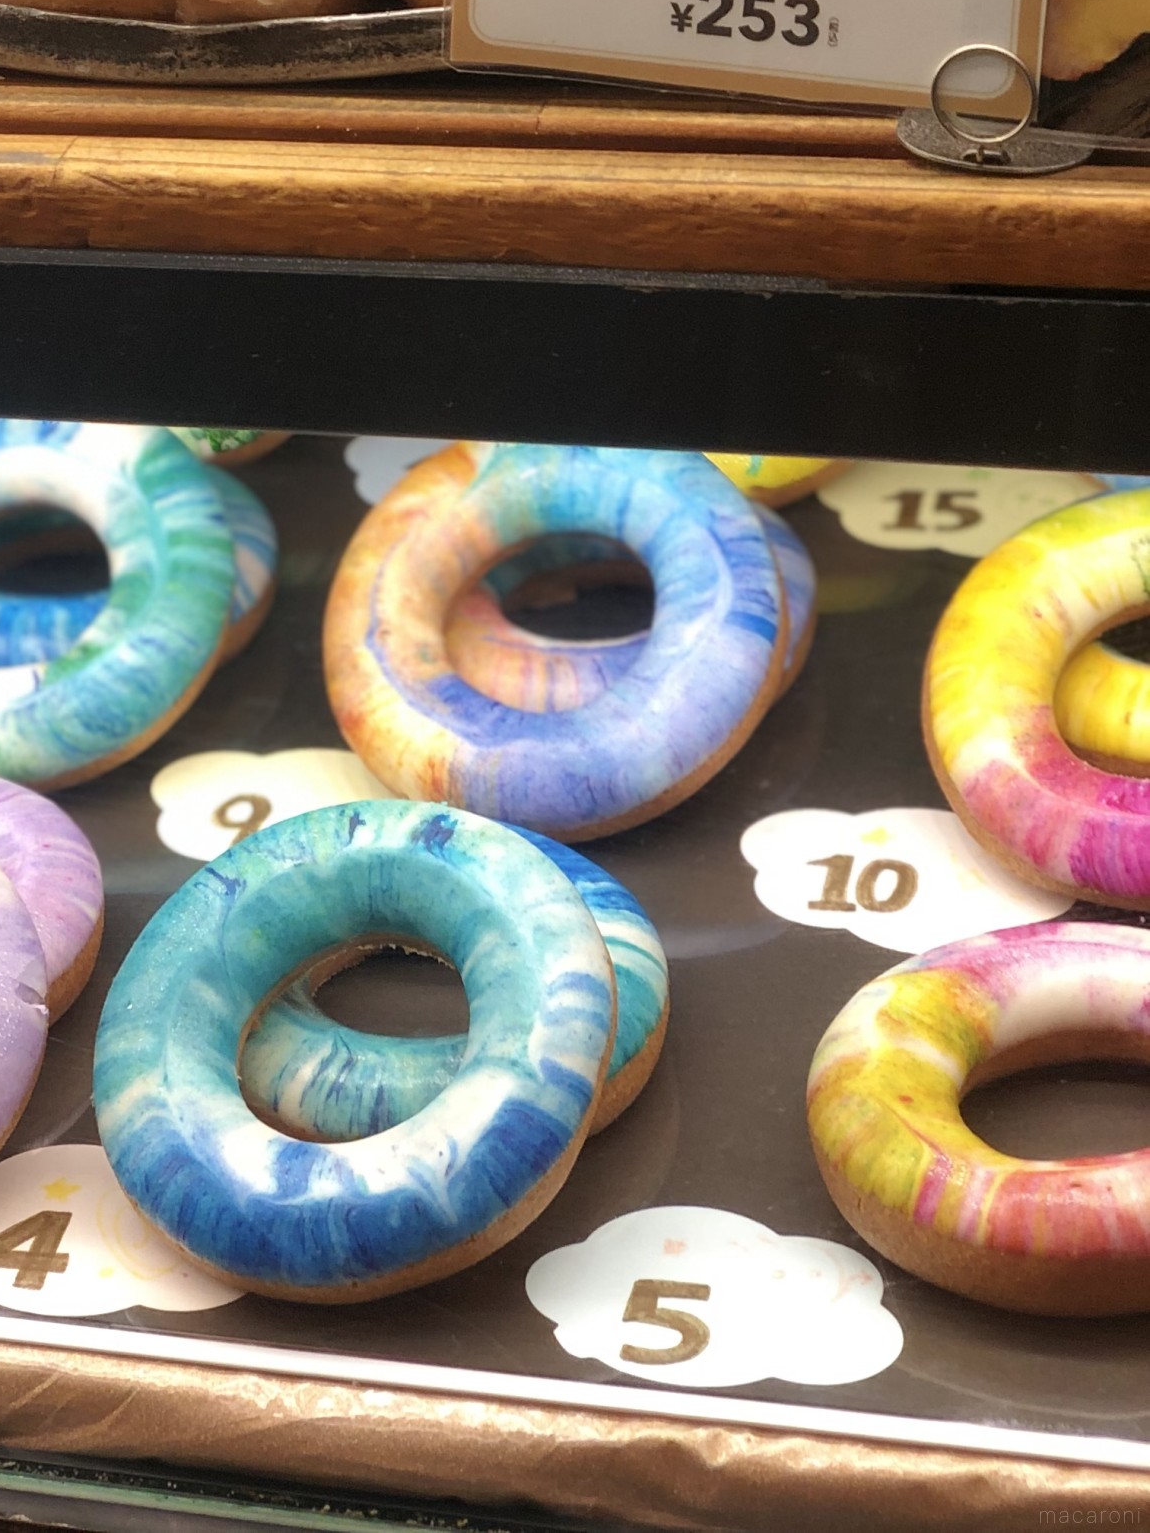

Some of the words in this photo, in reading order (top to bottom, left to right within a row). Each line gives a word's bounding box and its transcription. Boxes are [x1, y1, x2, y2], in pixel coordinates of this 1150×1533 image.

[881, 489, 983, 533] 15
[806, 854, 919, 914] 10
[619, 1278, 711, 1365] 5
